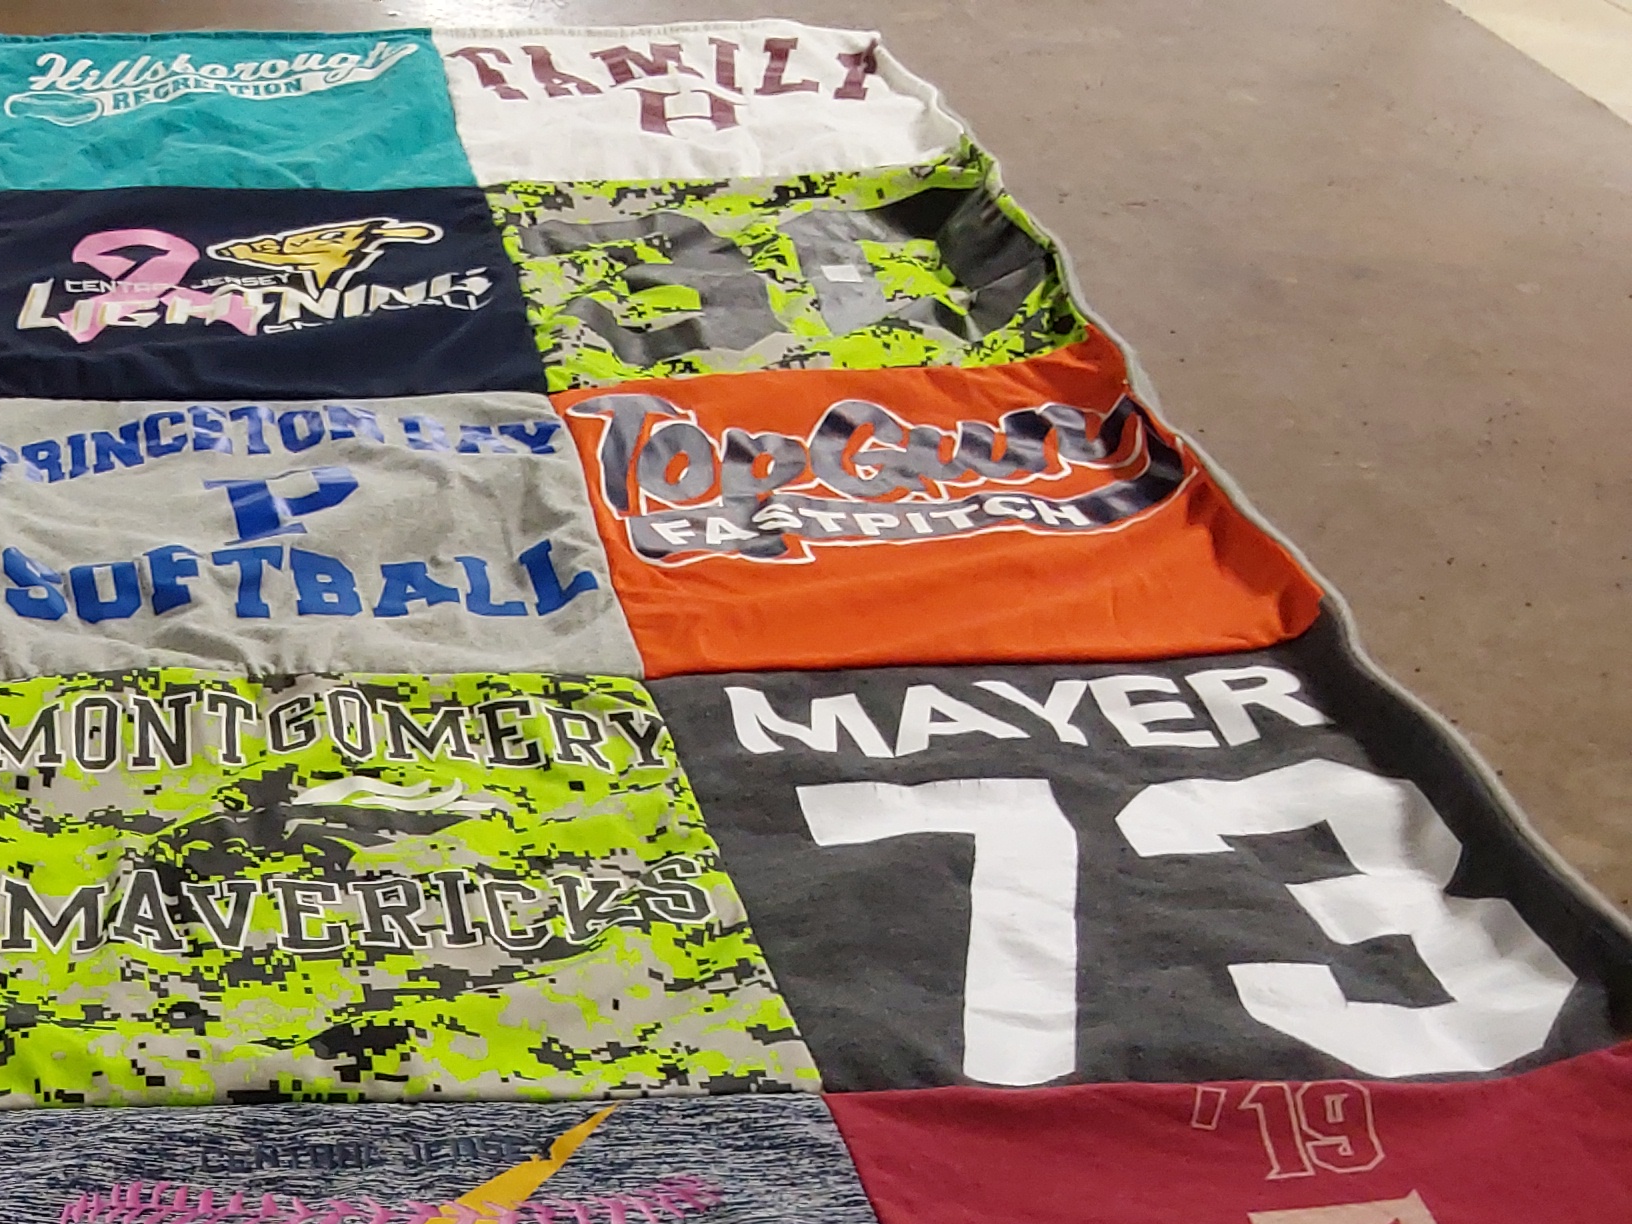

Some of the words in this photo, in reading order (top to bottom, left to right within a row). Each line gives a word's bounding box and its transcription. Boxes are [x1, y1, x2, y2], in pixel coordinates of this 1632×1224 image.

[28, 41, 419, 92] Hillsborough
[191, 272, 291, 290] JERSEY
[204, 466, 359, 545] P
[650, 496, 1094, 548] FASTPITCH
[2, 539, 599, 623] SOFTBALL
[723, 665, 1338, 759] MAYER
[795, 758, 1578, 1086] 73
